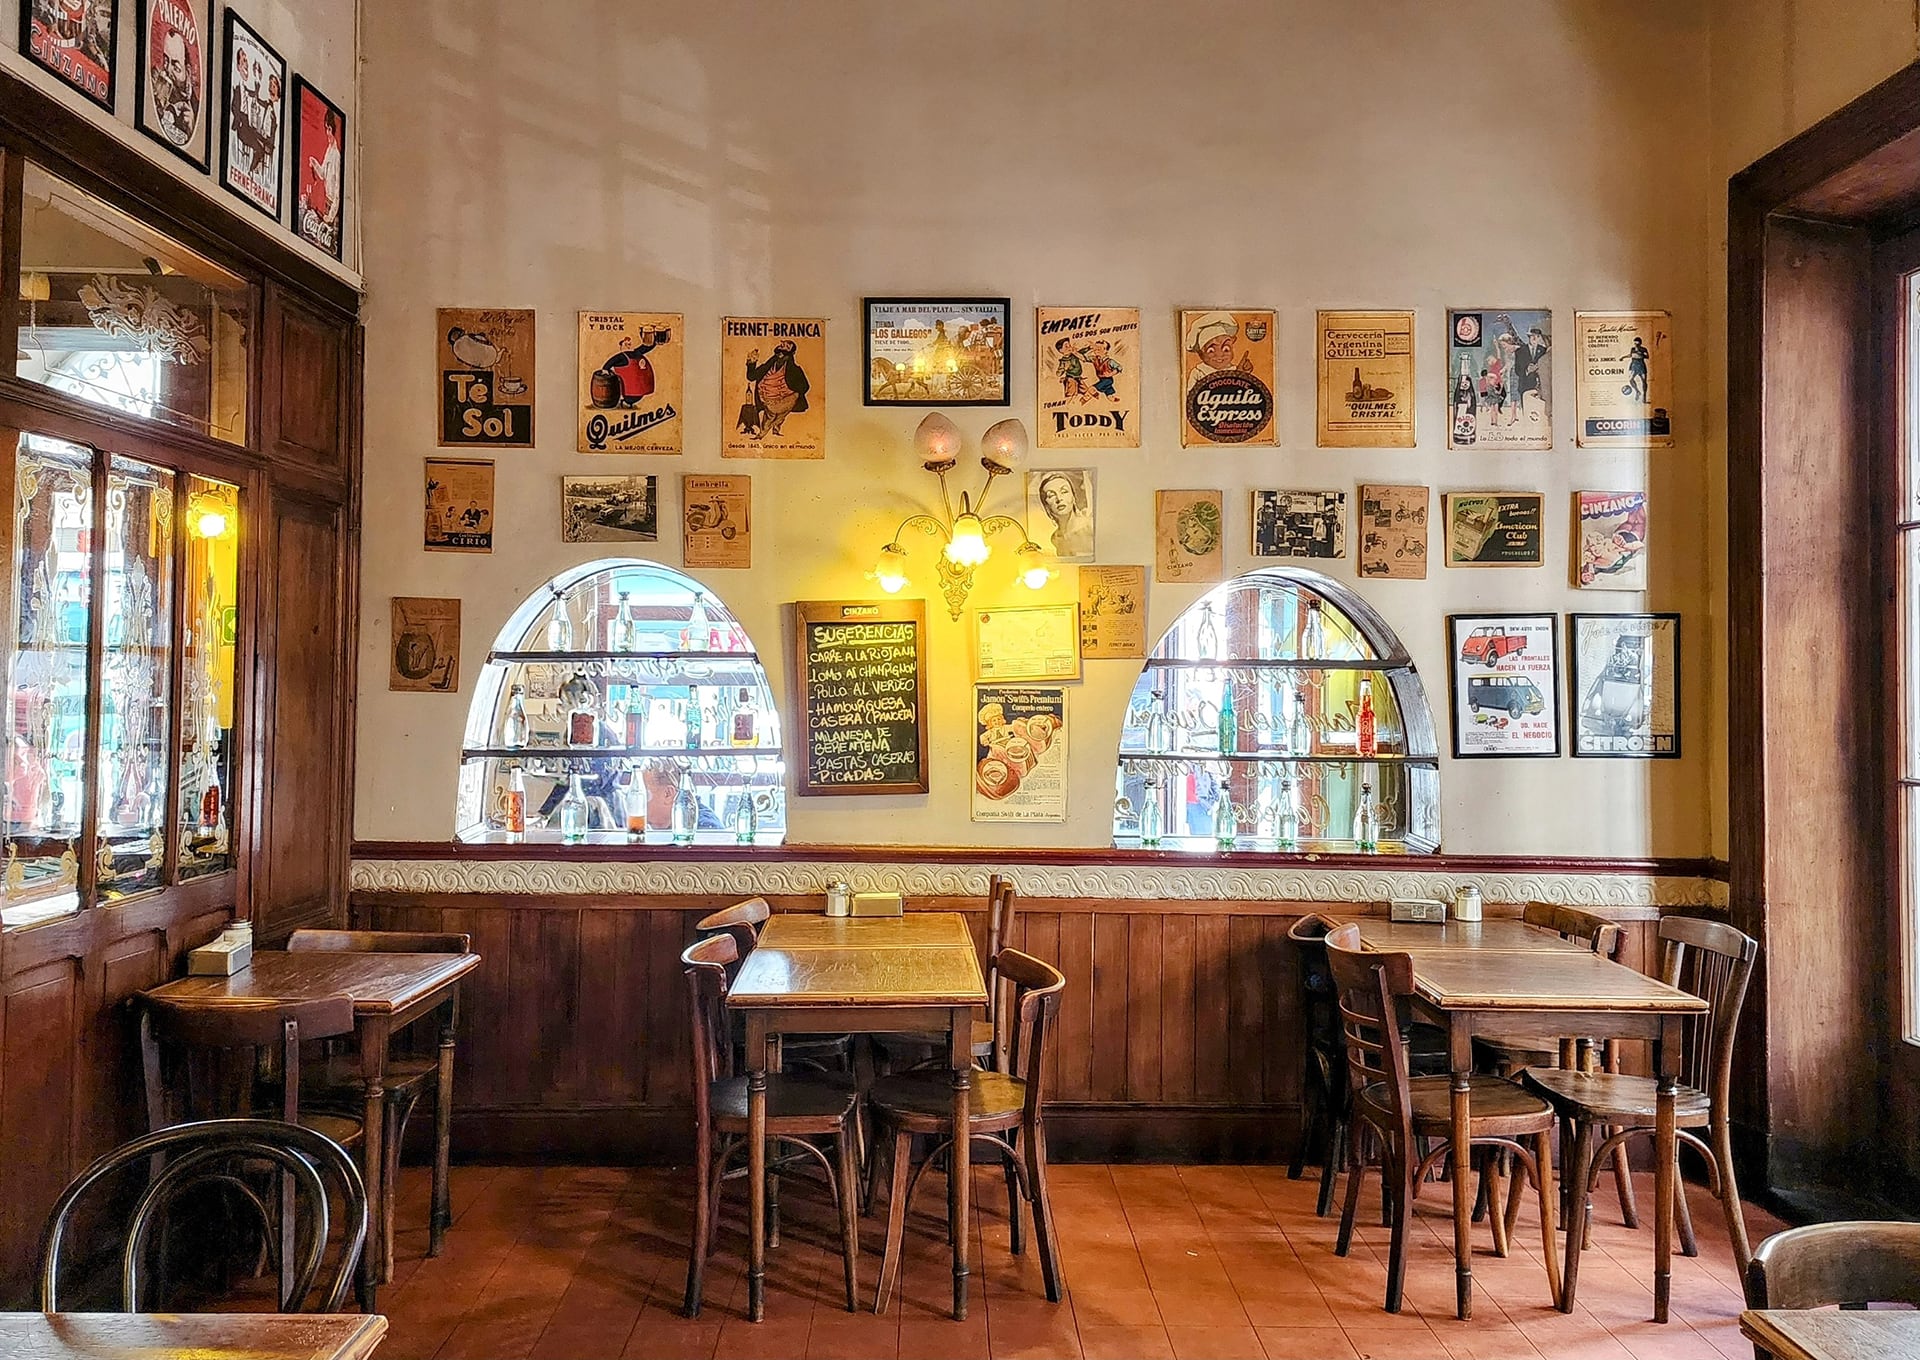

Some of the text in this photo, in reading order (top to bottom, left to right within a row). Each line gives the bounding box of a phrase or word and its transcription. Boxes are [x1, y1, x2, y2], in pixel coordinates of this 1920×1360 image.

[157, 0, 196, 45] PALERMO
[30, 23, 110, 100] CINZANO
[727, 321, 821, 337] FERNET-BRANCA
[1041, 313, 1101, 335] EMPATE!
[1085, 329, 1098, 337] DOS
[1327, 340, 1383, 349] Argentina
[1327, 349, 1383, 357] QUILMES
[449, 375, 488, 404] Té
[1197, 389, 1263, 411] Aguila
[462, 408, 514, 437] Sol
[1052, 410, 1129, 433] TODDY
[1197, 405, 1263, 427] Express
[586, 403, 676, 450] Quilmes
[1581, 497, 1636, 515] CINZANO
[1505, 531, 1528, 540] Club
[843, 606, 879, 616] CINZANO
[814, 624, 914, 644] SUGERENCIAS
[812, 668, 842, 682] LOMO
[814, 679, 915, 699] POLLO AL VERDEO
[810, 713, 862, 728] CASERA
[877, 727, 892, 738] DE
[1523, 731, 1552, 739] NEGOCIO
[815, 756, 867, 771] PASTAS
[815, 768, 885, 783] PICADAS
